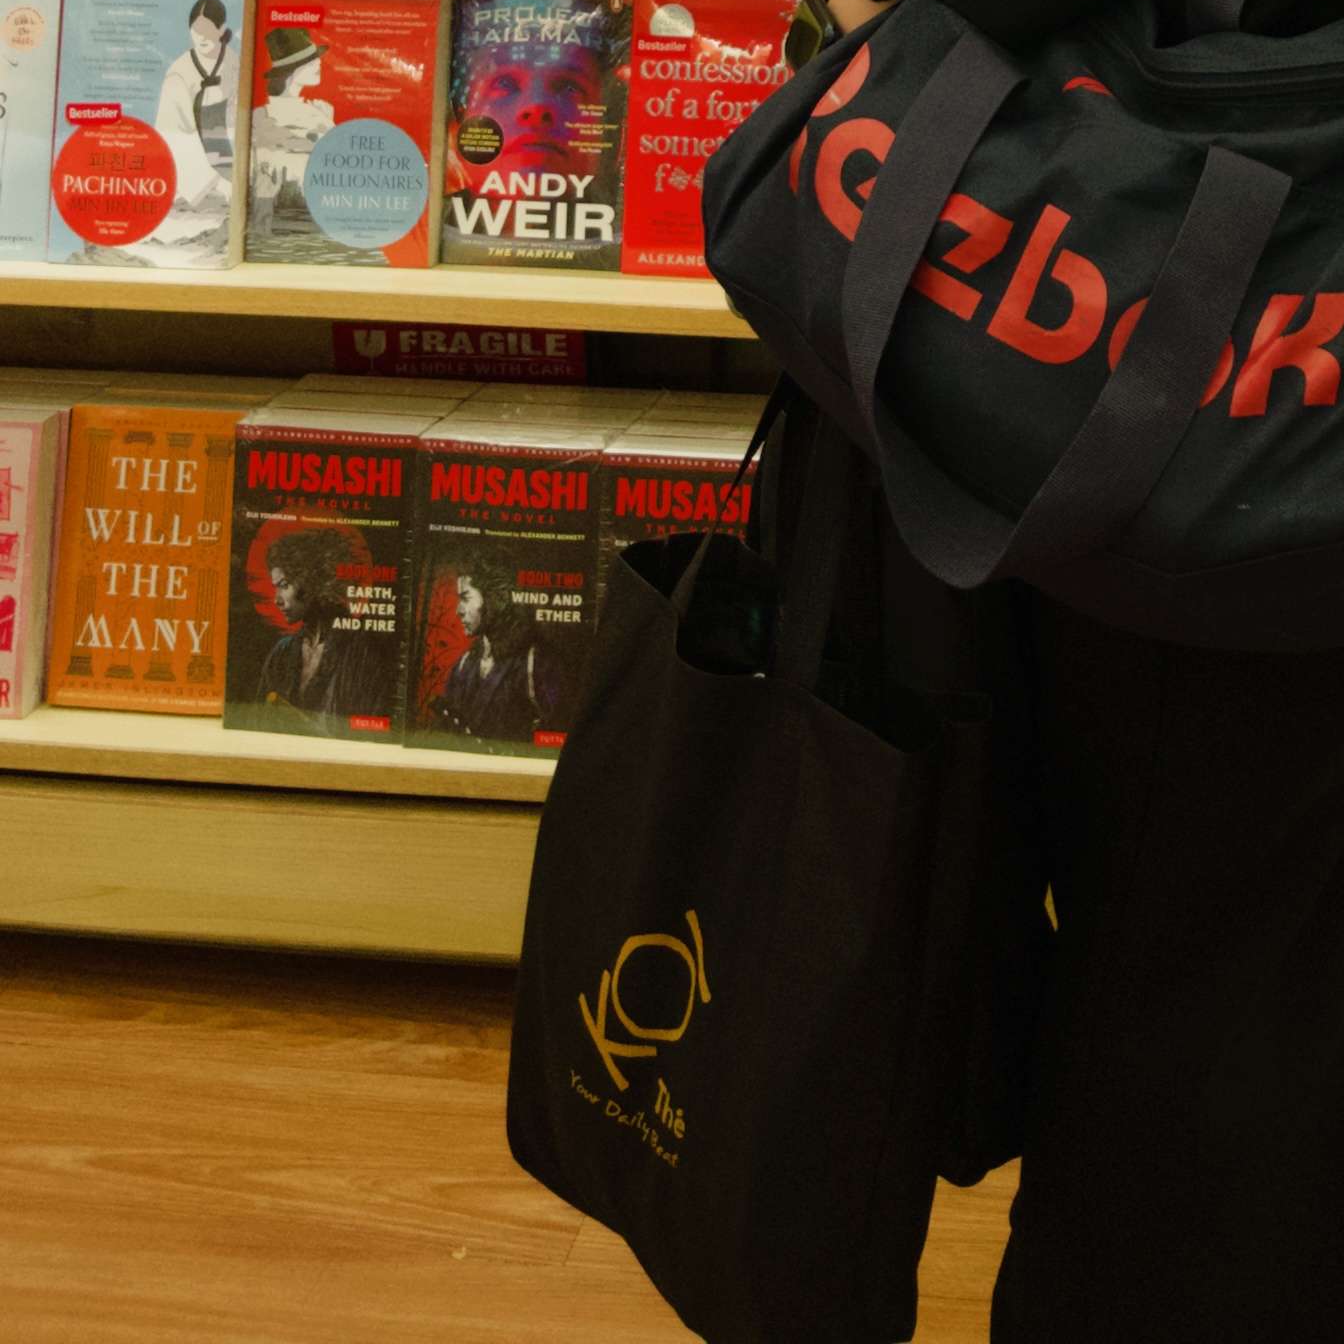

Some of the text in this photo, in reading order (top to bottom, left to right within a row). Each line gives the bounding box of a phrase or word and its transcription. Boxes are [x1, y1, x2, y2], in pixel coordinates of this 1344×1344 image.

[62, 173, 167, 197] PACHINKO
[479, 170, 595, 199] ANDY
[451, 195, 616, 242] WEIR
[399, 331, 569, 357] FRAGILE
[247, 450, 402, 498] MUSASHI
[84, 507, 193, 547] WILL
[349, 602, 396, 616] WATER
[510, 590, 583, 607] WIND AND
[535, 608, 581, 623] ETHER
[75, 613, 210, 654] MANY
